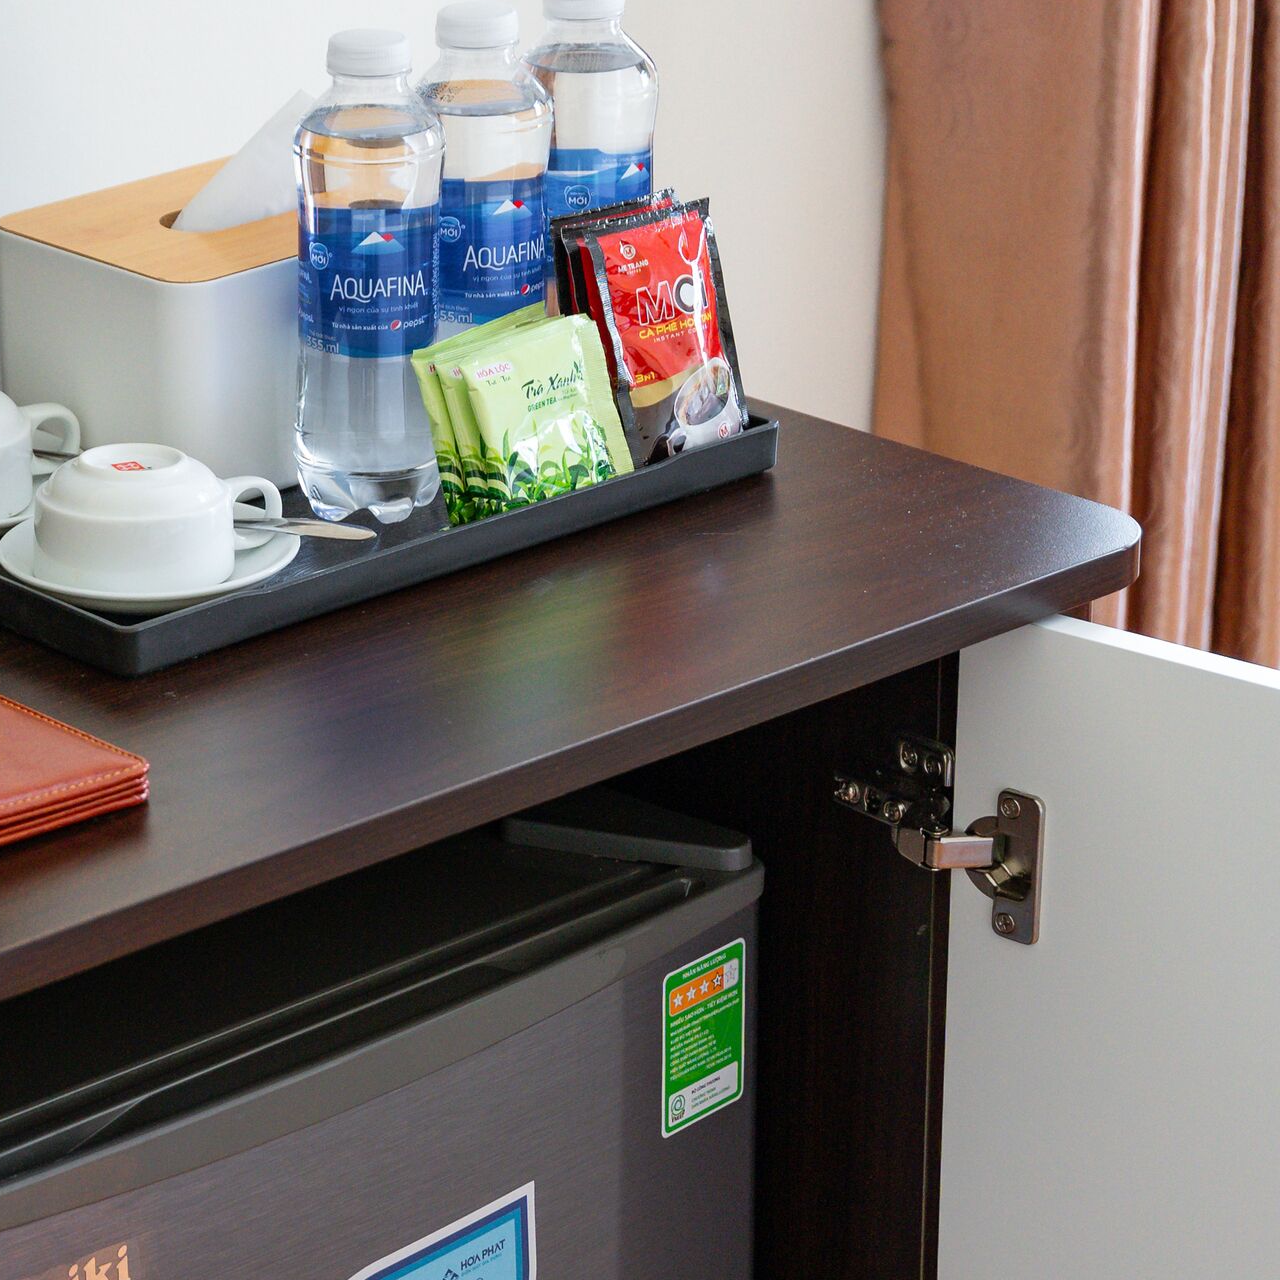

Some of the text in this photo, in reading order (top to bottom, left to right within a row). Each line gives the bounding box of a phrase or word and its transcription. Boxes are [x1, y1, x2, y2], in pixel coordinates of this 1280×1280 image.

[463, 234, 546, 271] AQUAFINA
[330, 270, 426, 303] AQUAFINA
[439, 310, 455, 322] 55
